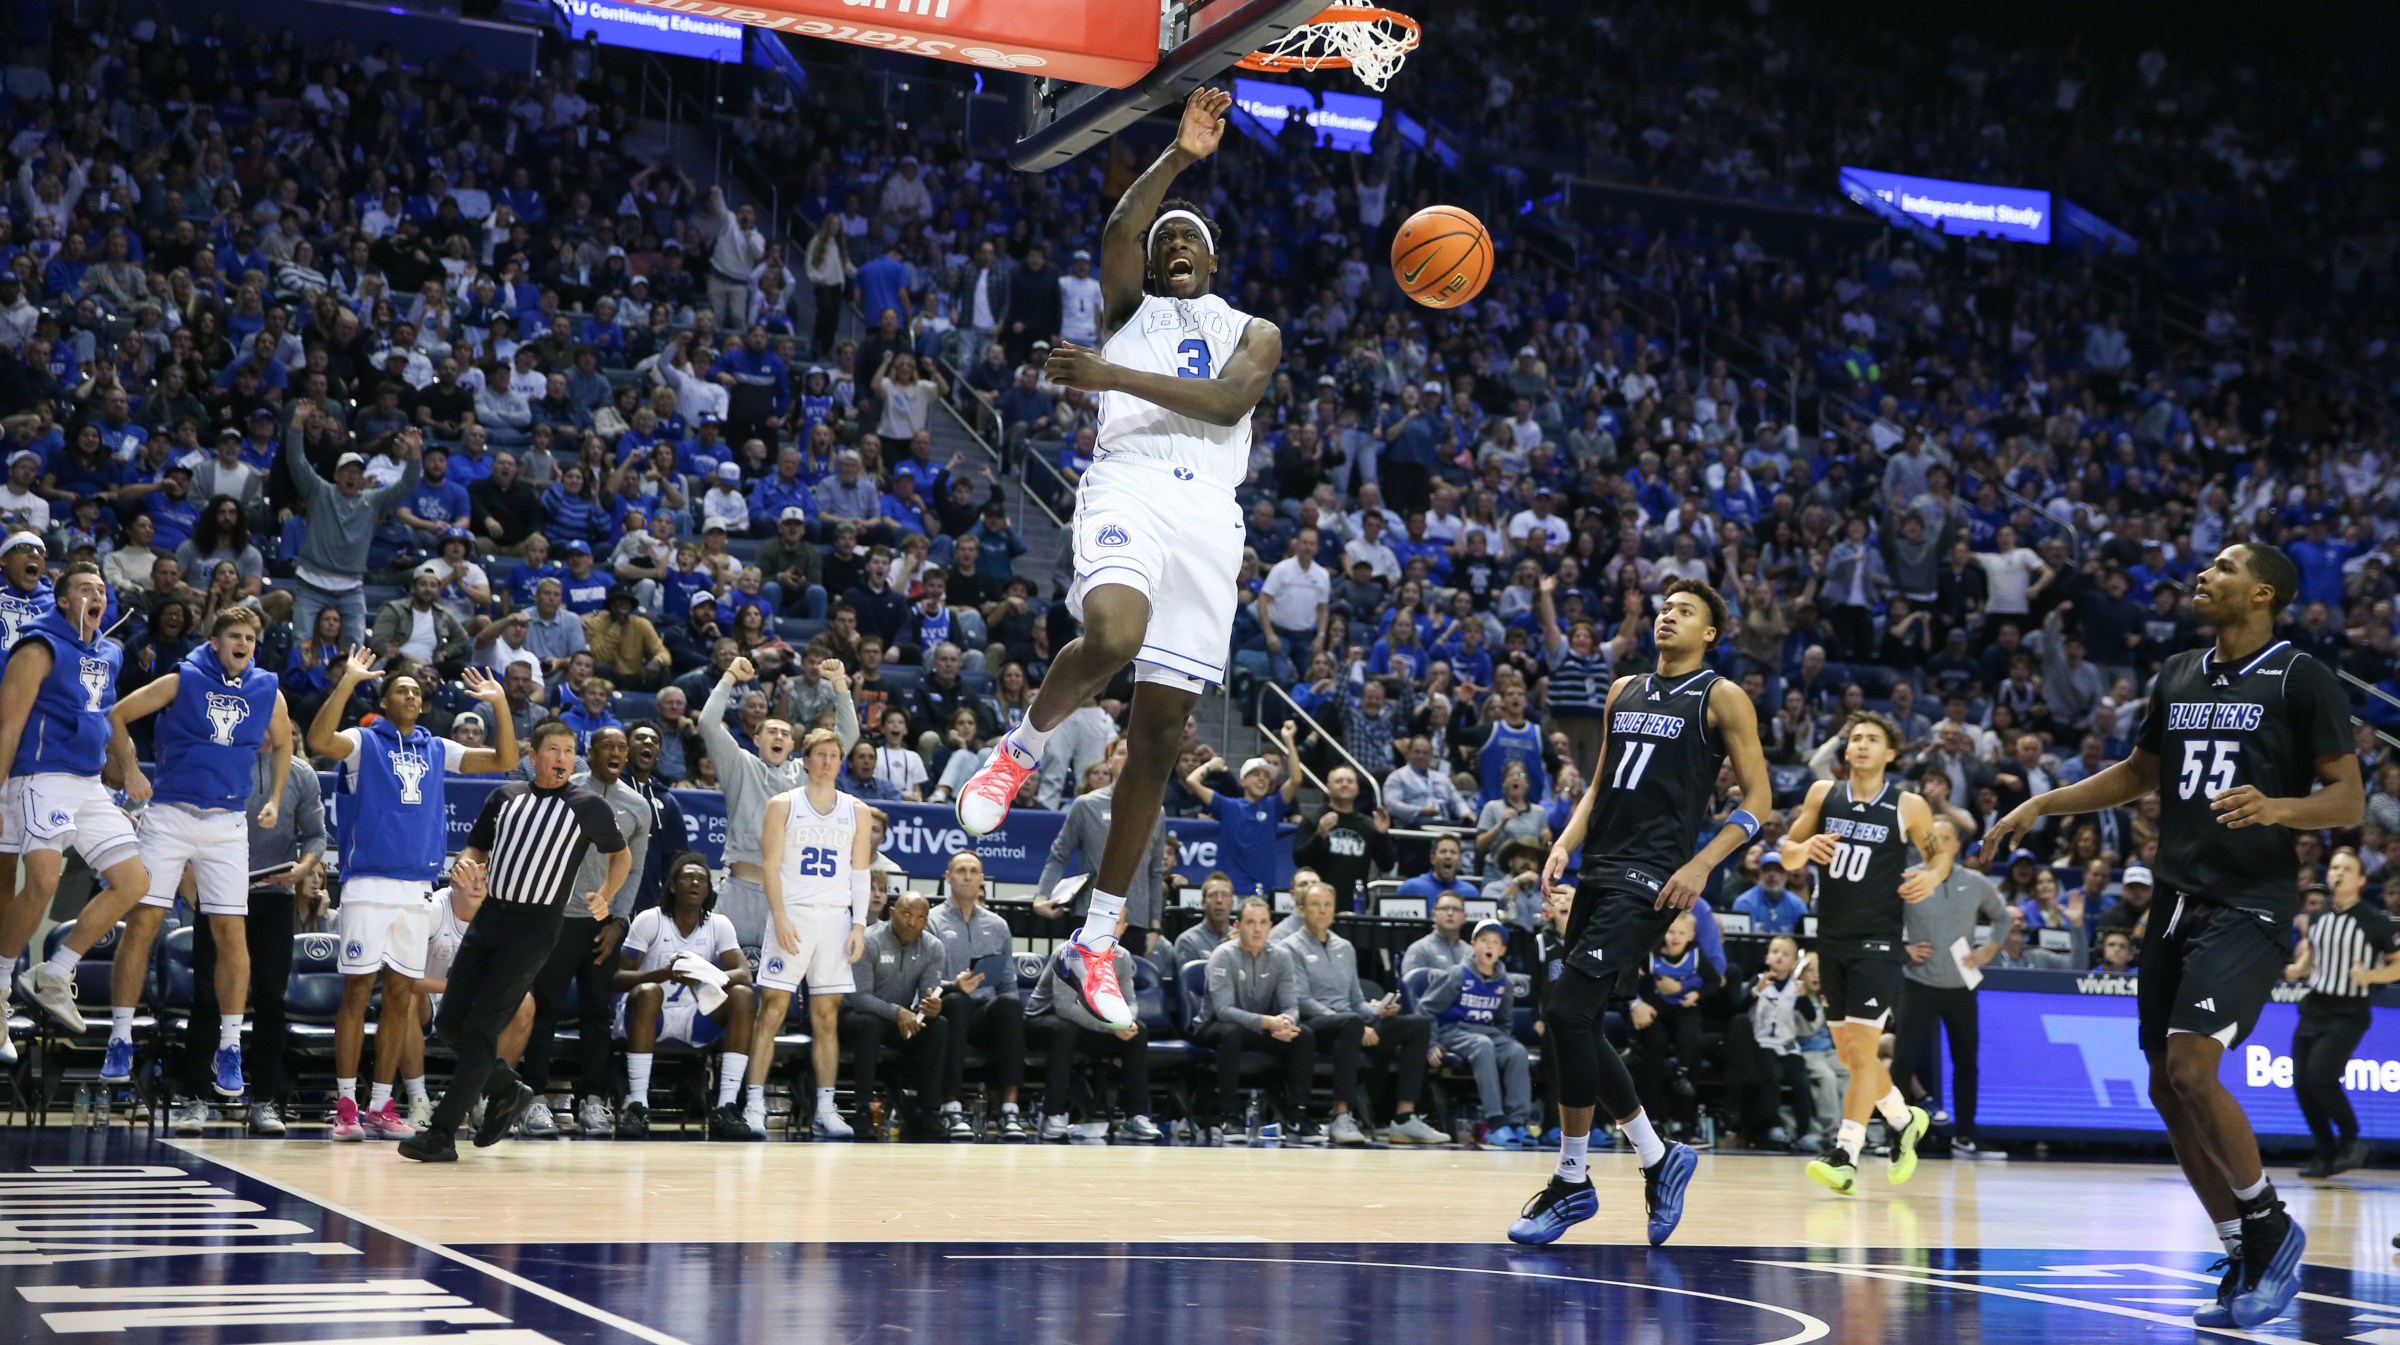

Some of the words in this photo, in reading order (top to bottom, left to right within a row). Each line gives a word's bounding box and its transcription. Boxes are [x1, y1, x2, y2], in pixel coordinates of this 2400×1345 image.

[590, 3, 669, 31] Continuing
[671, 15, 742, 40] Education
[1901, 193, 1995, 221] Independent
[1997, 204, 2042, 230] Study
[1147, 301, 1231, 345] BYU
[1177, 338, 1211, 379] 3
[1612, 712, 1646, 734] BLUE
[1641, 713, 1684, 739] HENS
[2168, 703, 2214, 731] BLUE
[2212, 703, 2264, 731] HENS
[1612, 741, 1655, 790] 11
[2179, 740, 2241, 800] 55
[794, 825, 849, 848] BYU
[976, 829, 1008, 844] pest
[1825, 816, 1856, 838] BLUE
[1852, 822, 1889, 843] HENS
[800, 847, 838, 878] 25
[975, 846, 1025, 859] control
[1828, 841, 1873, 882] 00
[2246, 1045, 2400, 1094] Beme
